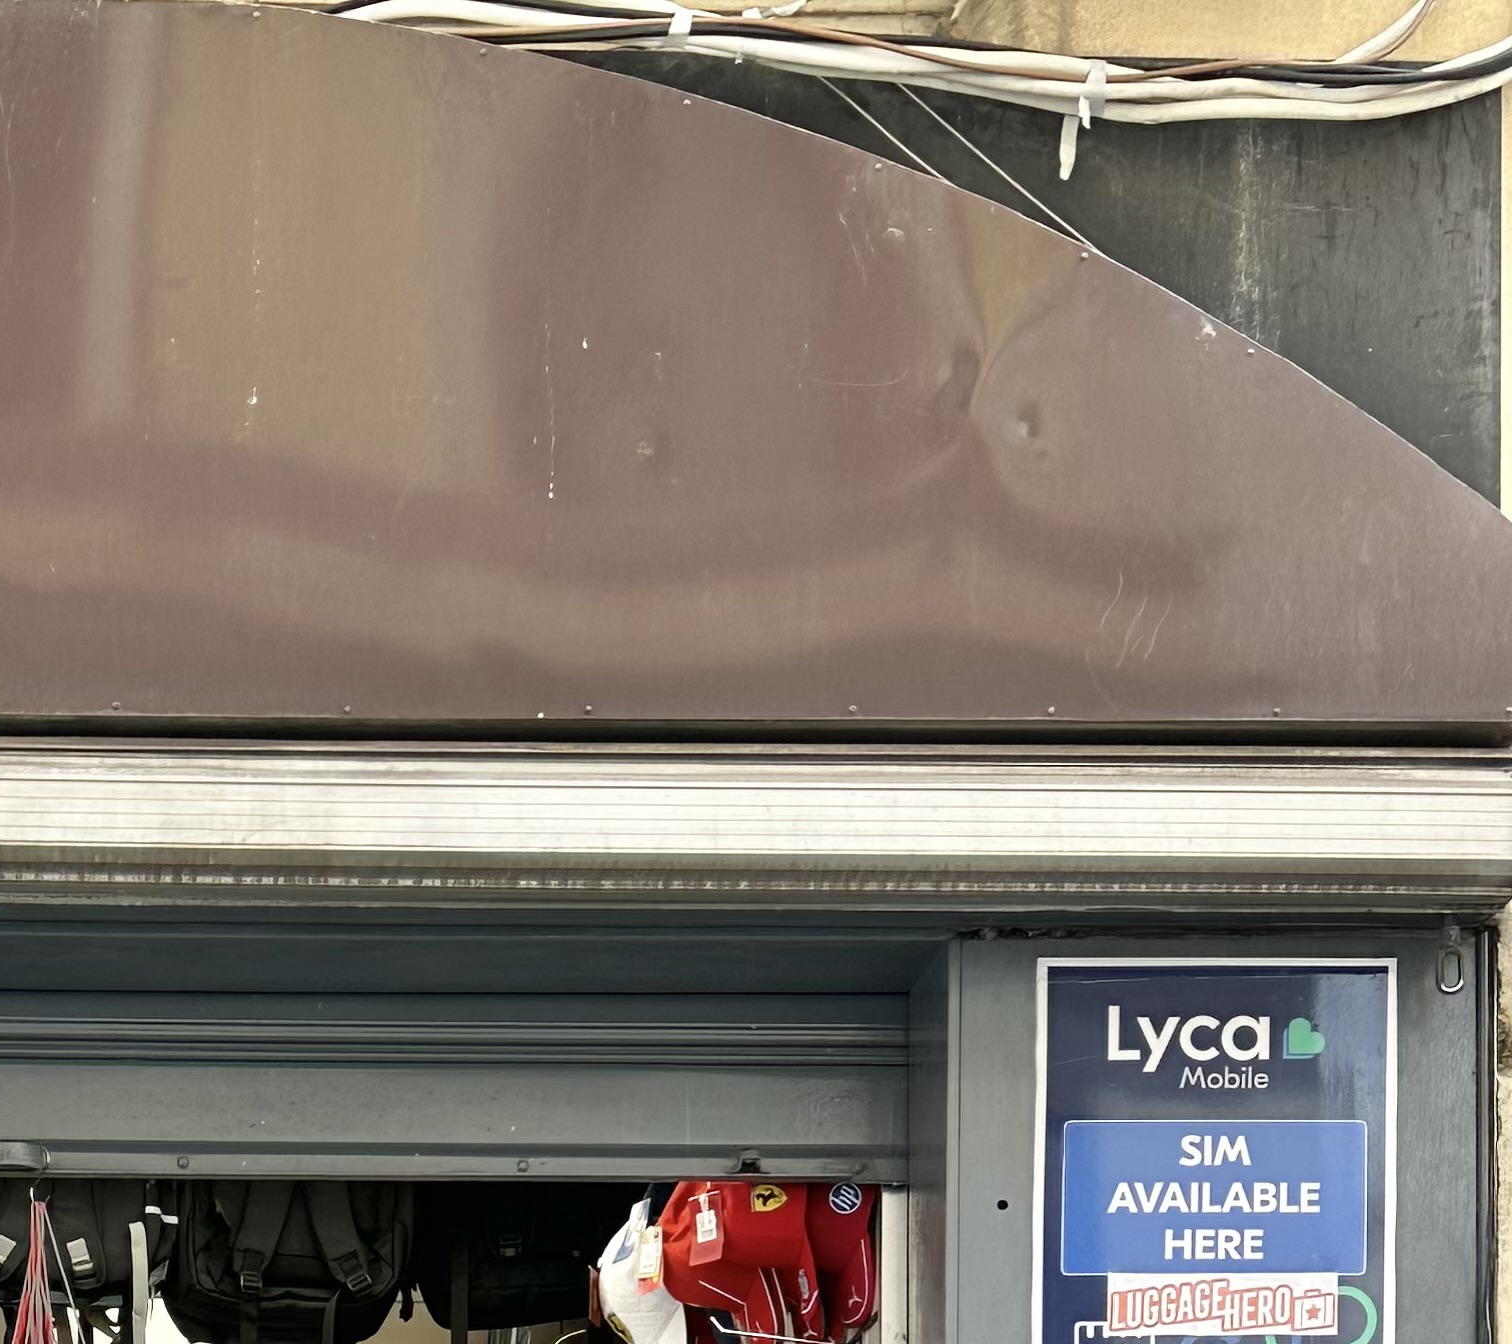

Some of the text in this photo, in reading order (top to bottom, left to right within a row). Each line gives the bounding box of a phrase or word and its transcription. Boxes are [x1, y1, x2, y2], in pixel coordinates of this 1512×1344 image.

[1108, 1006, 1270, 1073] Lyca
[1180, 1066, 1269, 1089] Mobile
[1180, 1135, 1250, 1165] SIM
[1107, 1183, 1320, 1213] AVAILABLE
[1164, 1229, 1263, 1260] HERE
